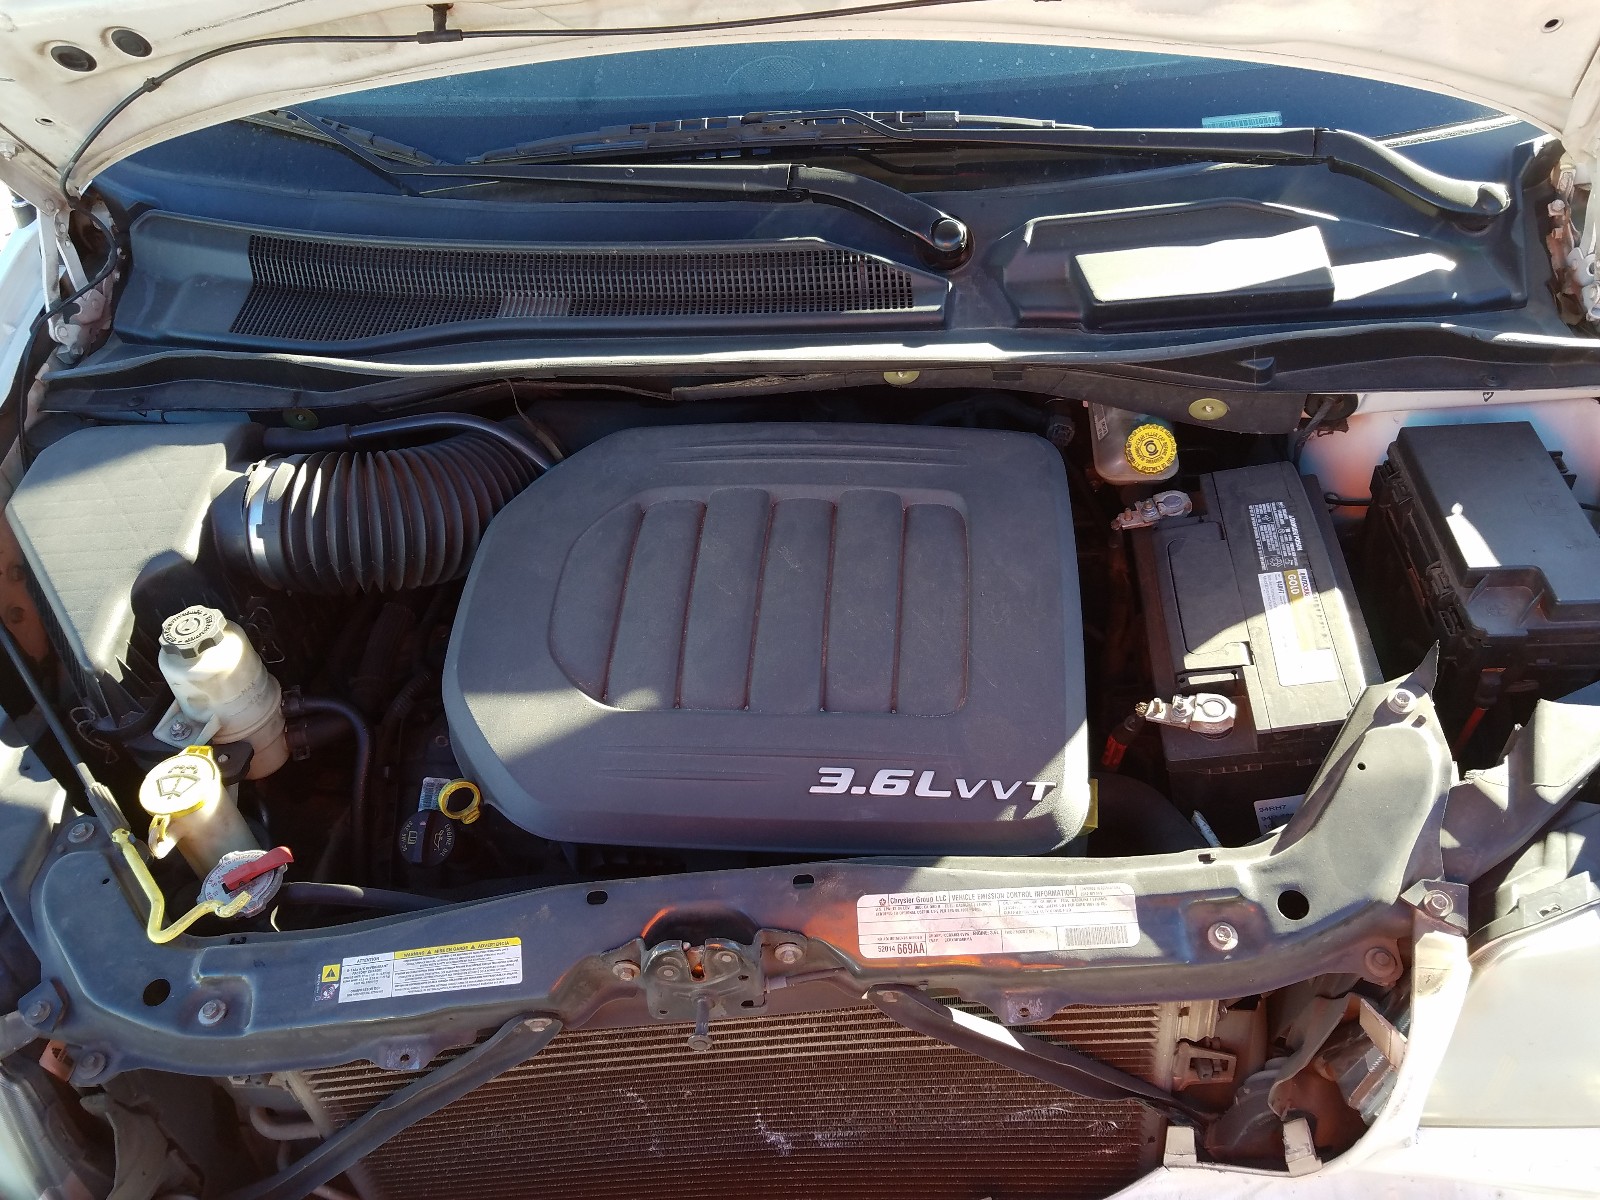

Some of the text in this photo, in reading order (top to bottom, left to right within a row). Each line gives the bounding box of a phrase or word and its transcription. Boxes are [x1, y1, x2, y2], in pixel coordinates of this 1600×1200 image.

[1287, 574, 1300, 595] GOLD
[956, 777, 1058, 801] VVT
[440, 823, 453, 857] ENGINE OIL
[890, 894, 947, 905] Chrysler Group LLC
[951, 893, 976, 901] VEHICLE
[977, 891, 1005, 900] EMISSION
[1006, 890, 1032, 899] CONTROL
[1034, 888, 1075, 897] INFORMATION
[877, 942, 925, 955] 52014 669AA
